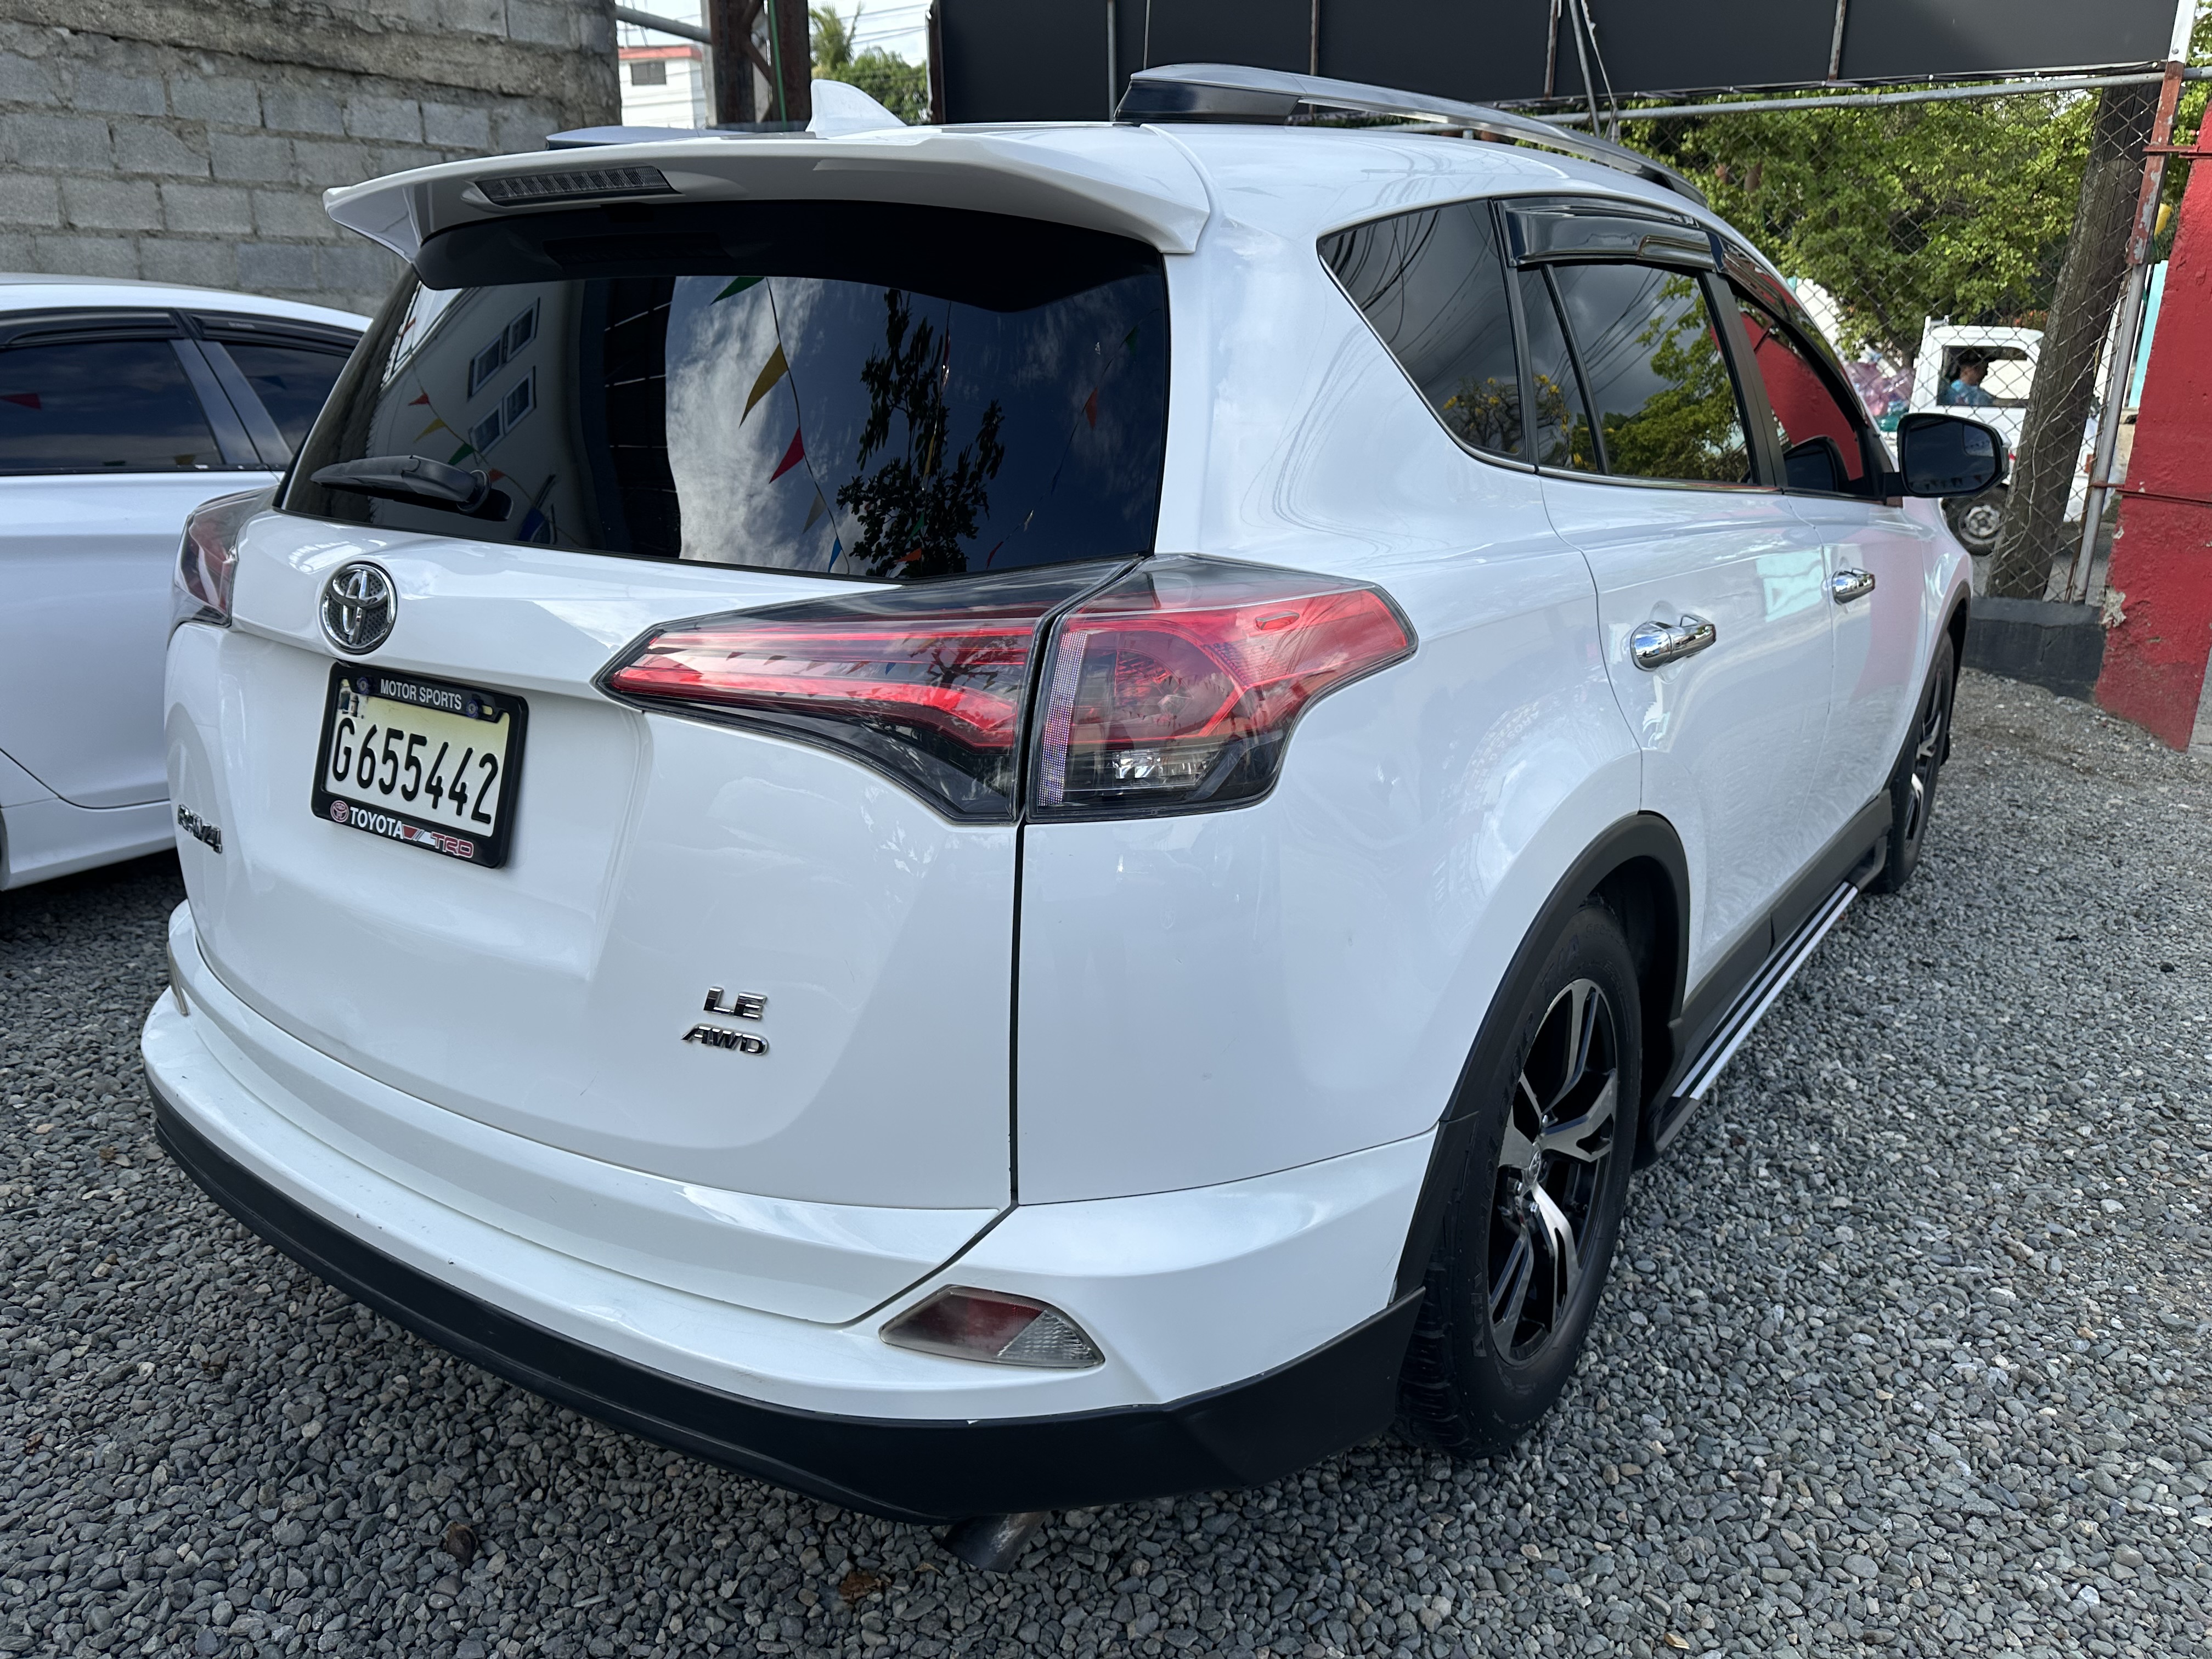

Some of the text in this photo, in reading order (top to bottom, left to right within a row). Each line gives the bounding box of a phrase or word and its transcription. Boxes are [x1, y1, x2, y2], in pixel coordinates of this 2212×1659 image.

[380, 679, 462, 710] MOTOR SPORTS
[332, 718, 499, 825] G655442
[349, 806, 474, 859] TOYOTA TRD
[703, 986, 768, 1022] LE
[681, 1023, 769, 1055] AWD
